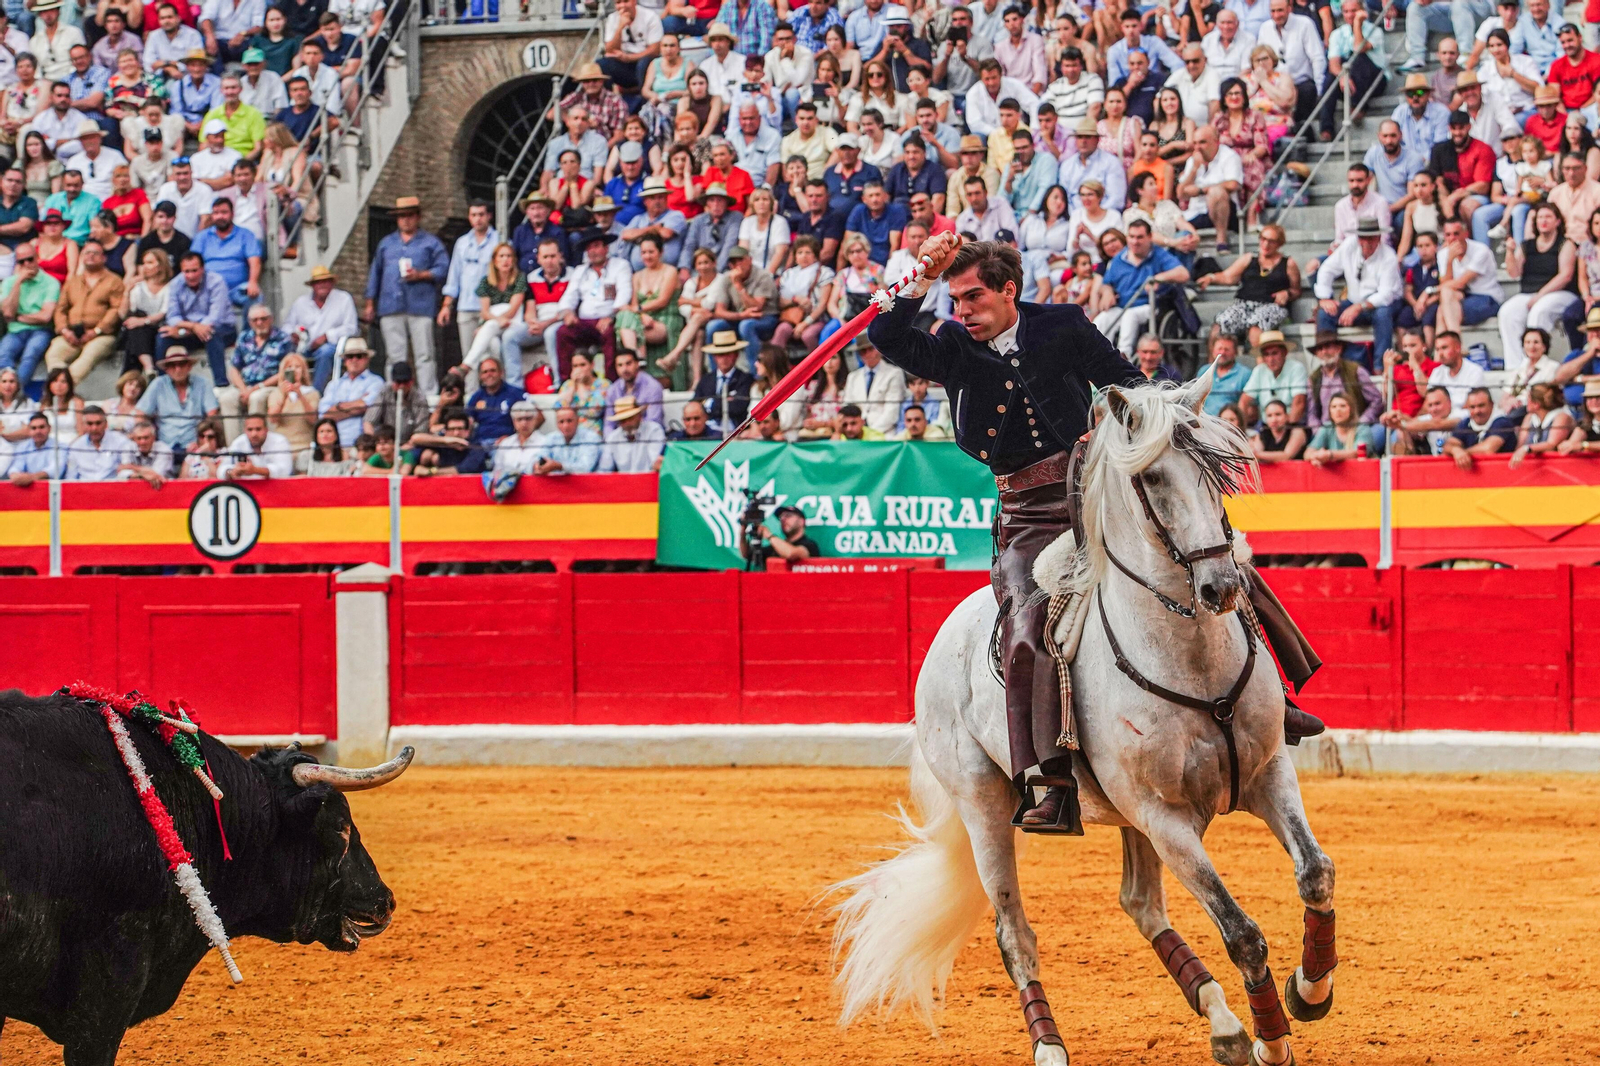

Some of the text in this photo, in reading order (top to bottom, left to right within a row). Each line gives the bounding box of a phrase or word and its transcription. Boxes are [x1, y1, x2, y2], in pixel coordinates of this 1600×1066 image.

[529, 44, 550, 68] 10
[209, 494, 241, 546] 10
[795, 495, 877, 529] CAJA
[834, 530, 958, 556] GRANADA
